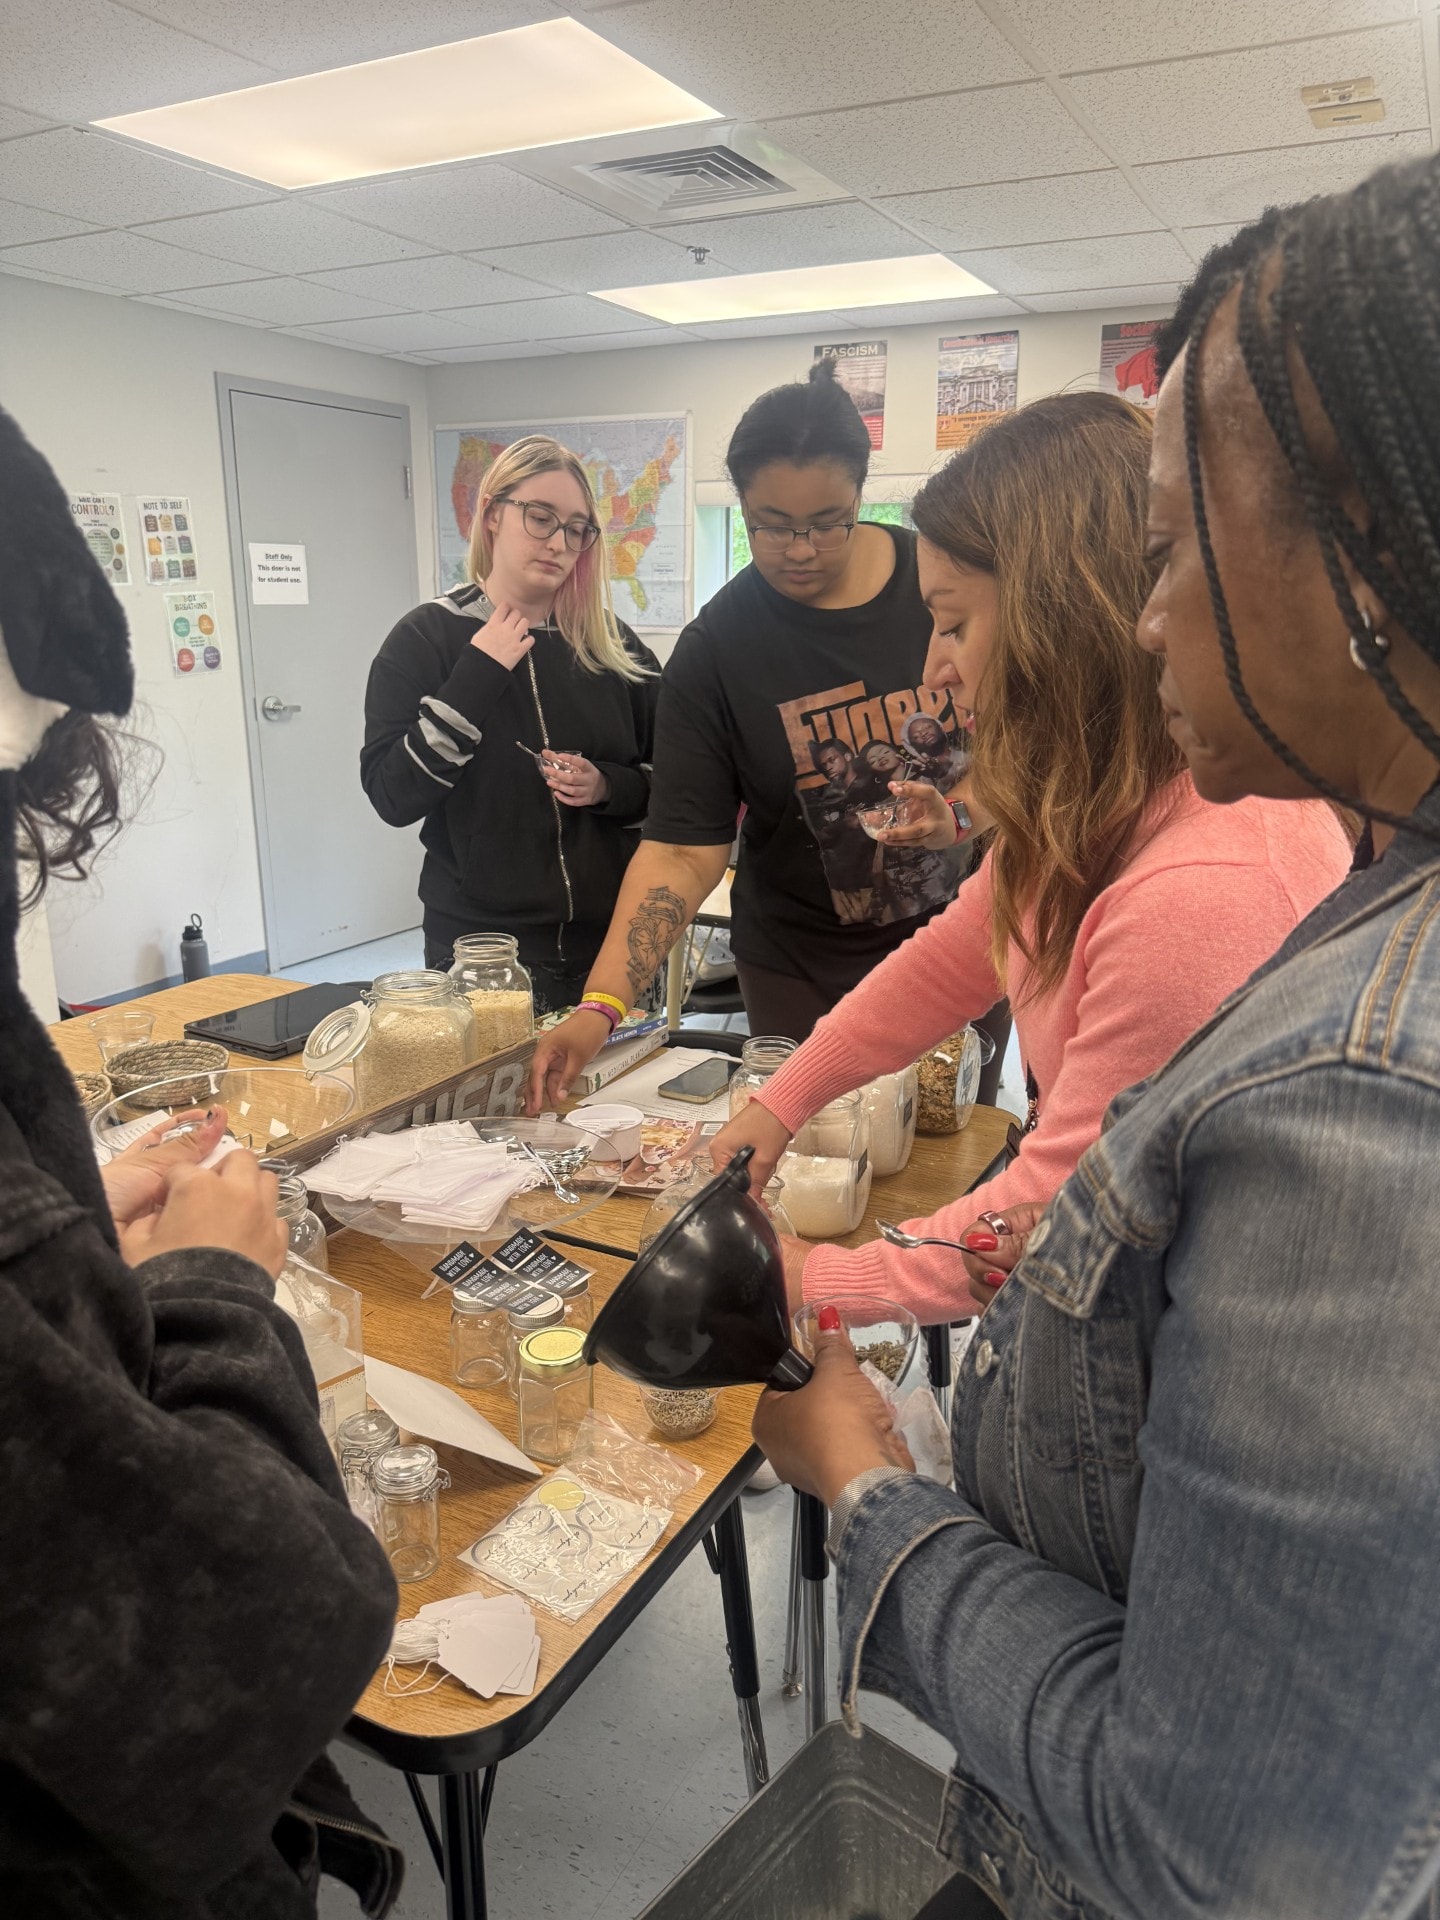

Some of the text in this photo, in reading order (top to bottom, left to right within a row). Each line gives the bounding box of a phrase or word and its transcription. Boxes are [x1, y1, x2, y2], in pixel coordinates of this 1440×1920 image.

[822, 345, 878, 358] FASCISM
[71, 504, 115, 516] CONTROL?
[143, 501, 183, 510] NOTE TO SELF
[280, 553, 293, 561] Only
